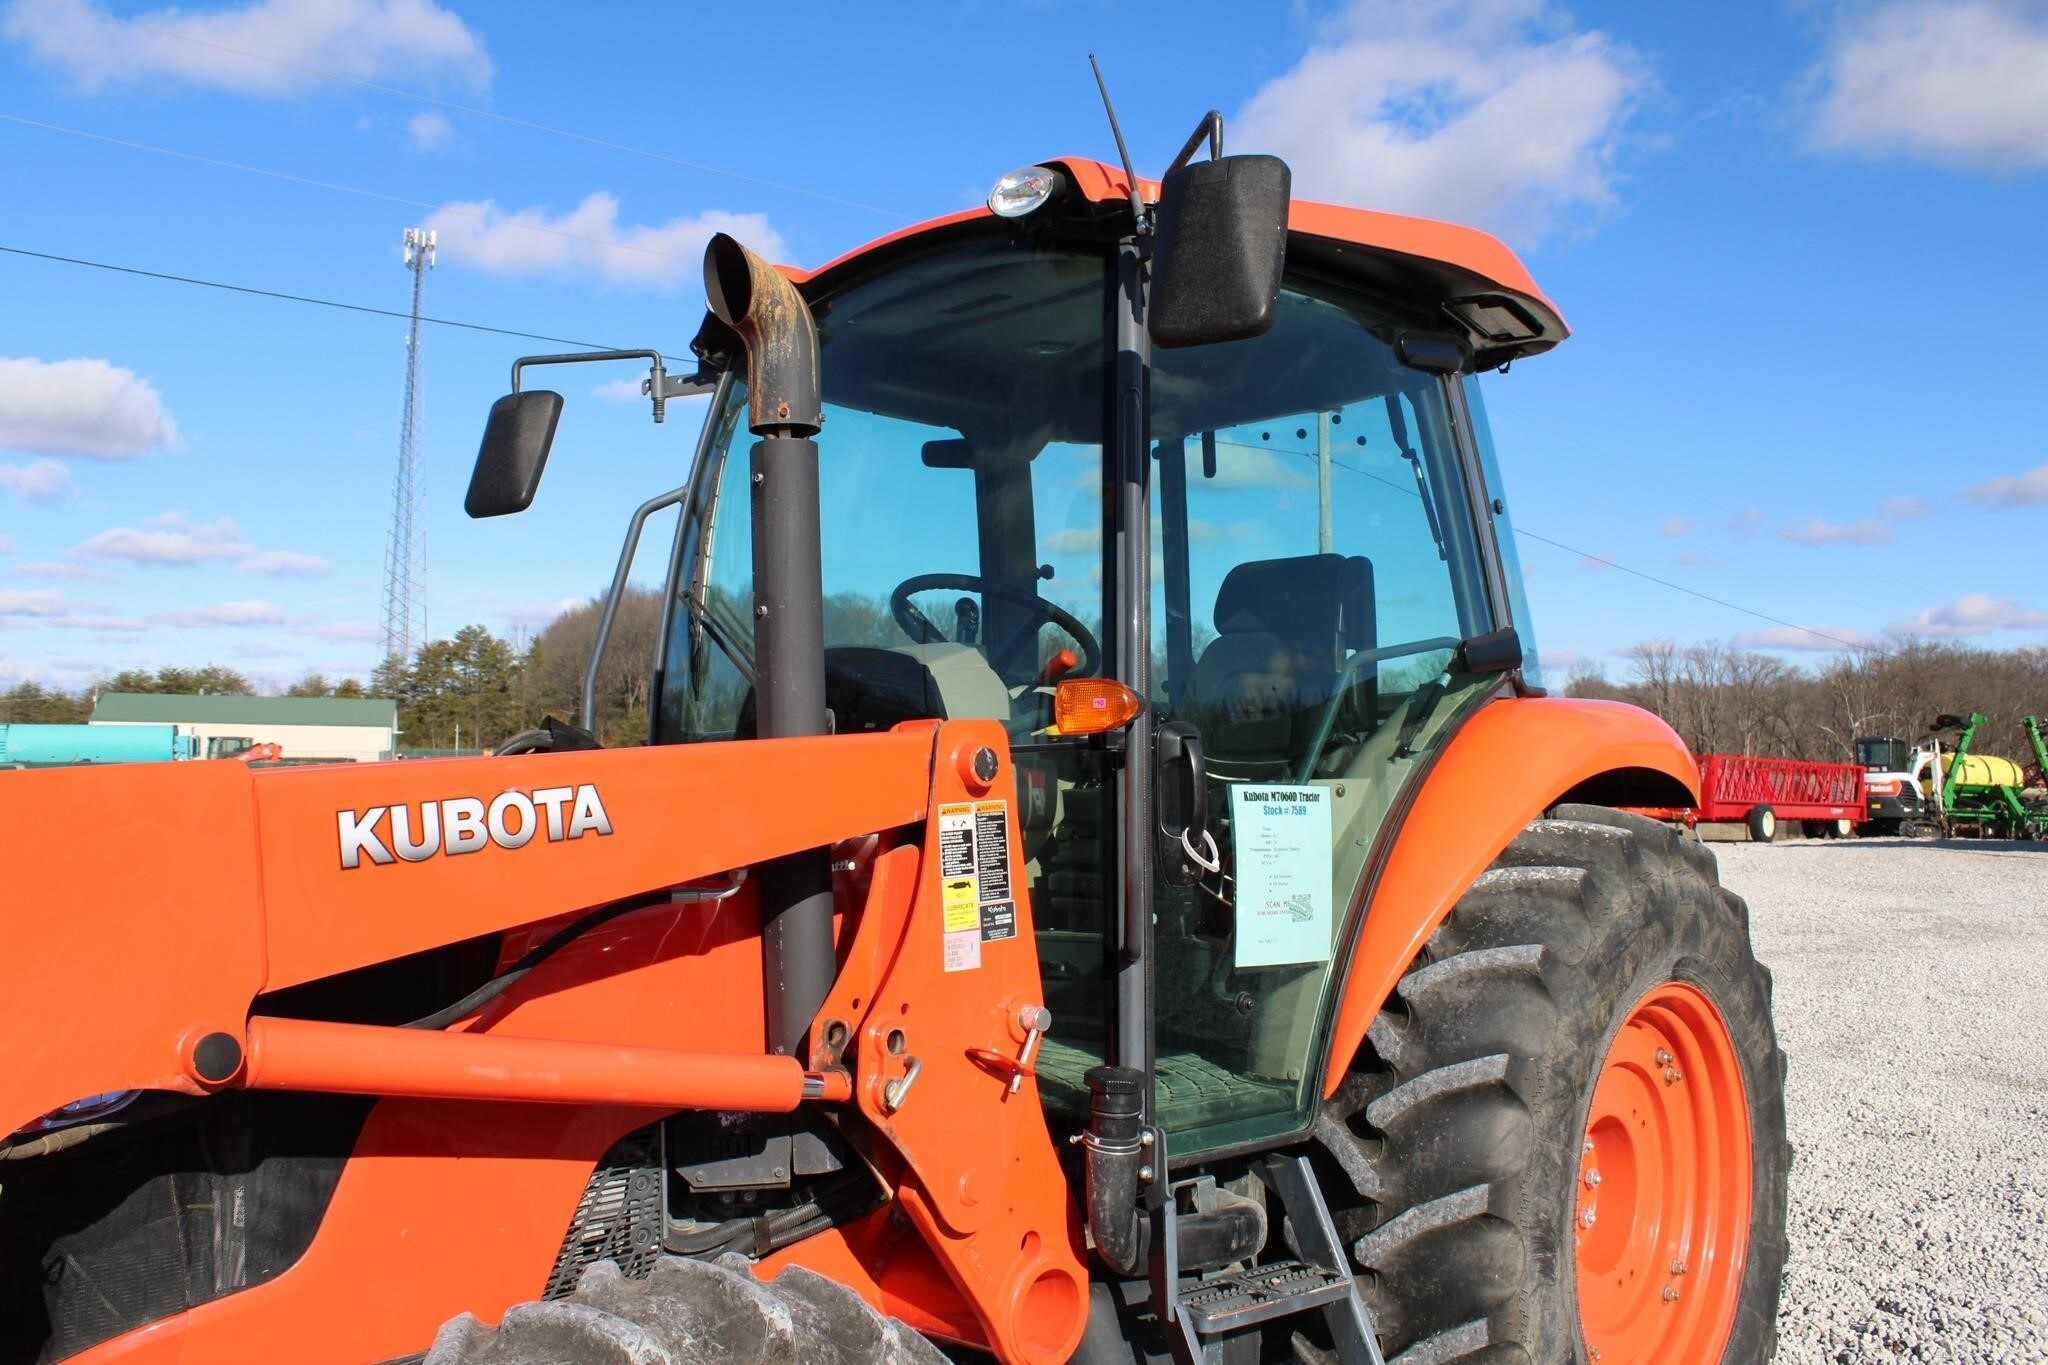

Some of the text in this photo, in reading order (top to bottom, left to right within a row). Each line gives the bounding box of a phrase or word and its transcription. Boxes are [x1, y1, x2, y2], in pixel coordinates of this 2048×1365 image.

[1243, 791, 1269, 802] Kubota
[1299, 792, 1320, 803] Tractor
[981, 803, 1003, 811] WARNING
[1263, 805, 1283, 816] Stock
[1291, 805, 1307, 816] 7589
[336, 783, 614, 871] KUBOTA
[988, 905, 1006, 913] Kubota
[1265, 900, 1280, 909] SCAN
